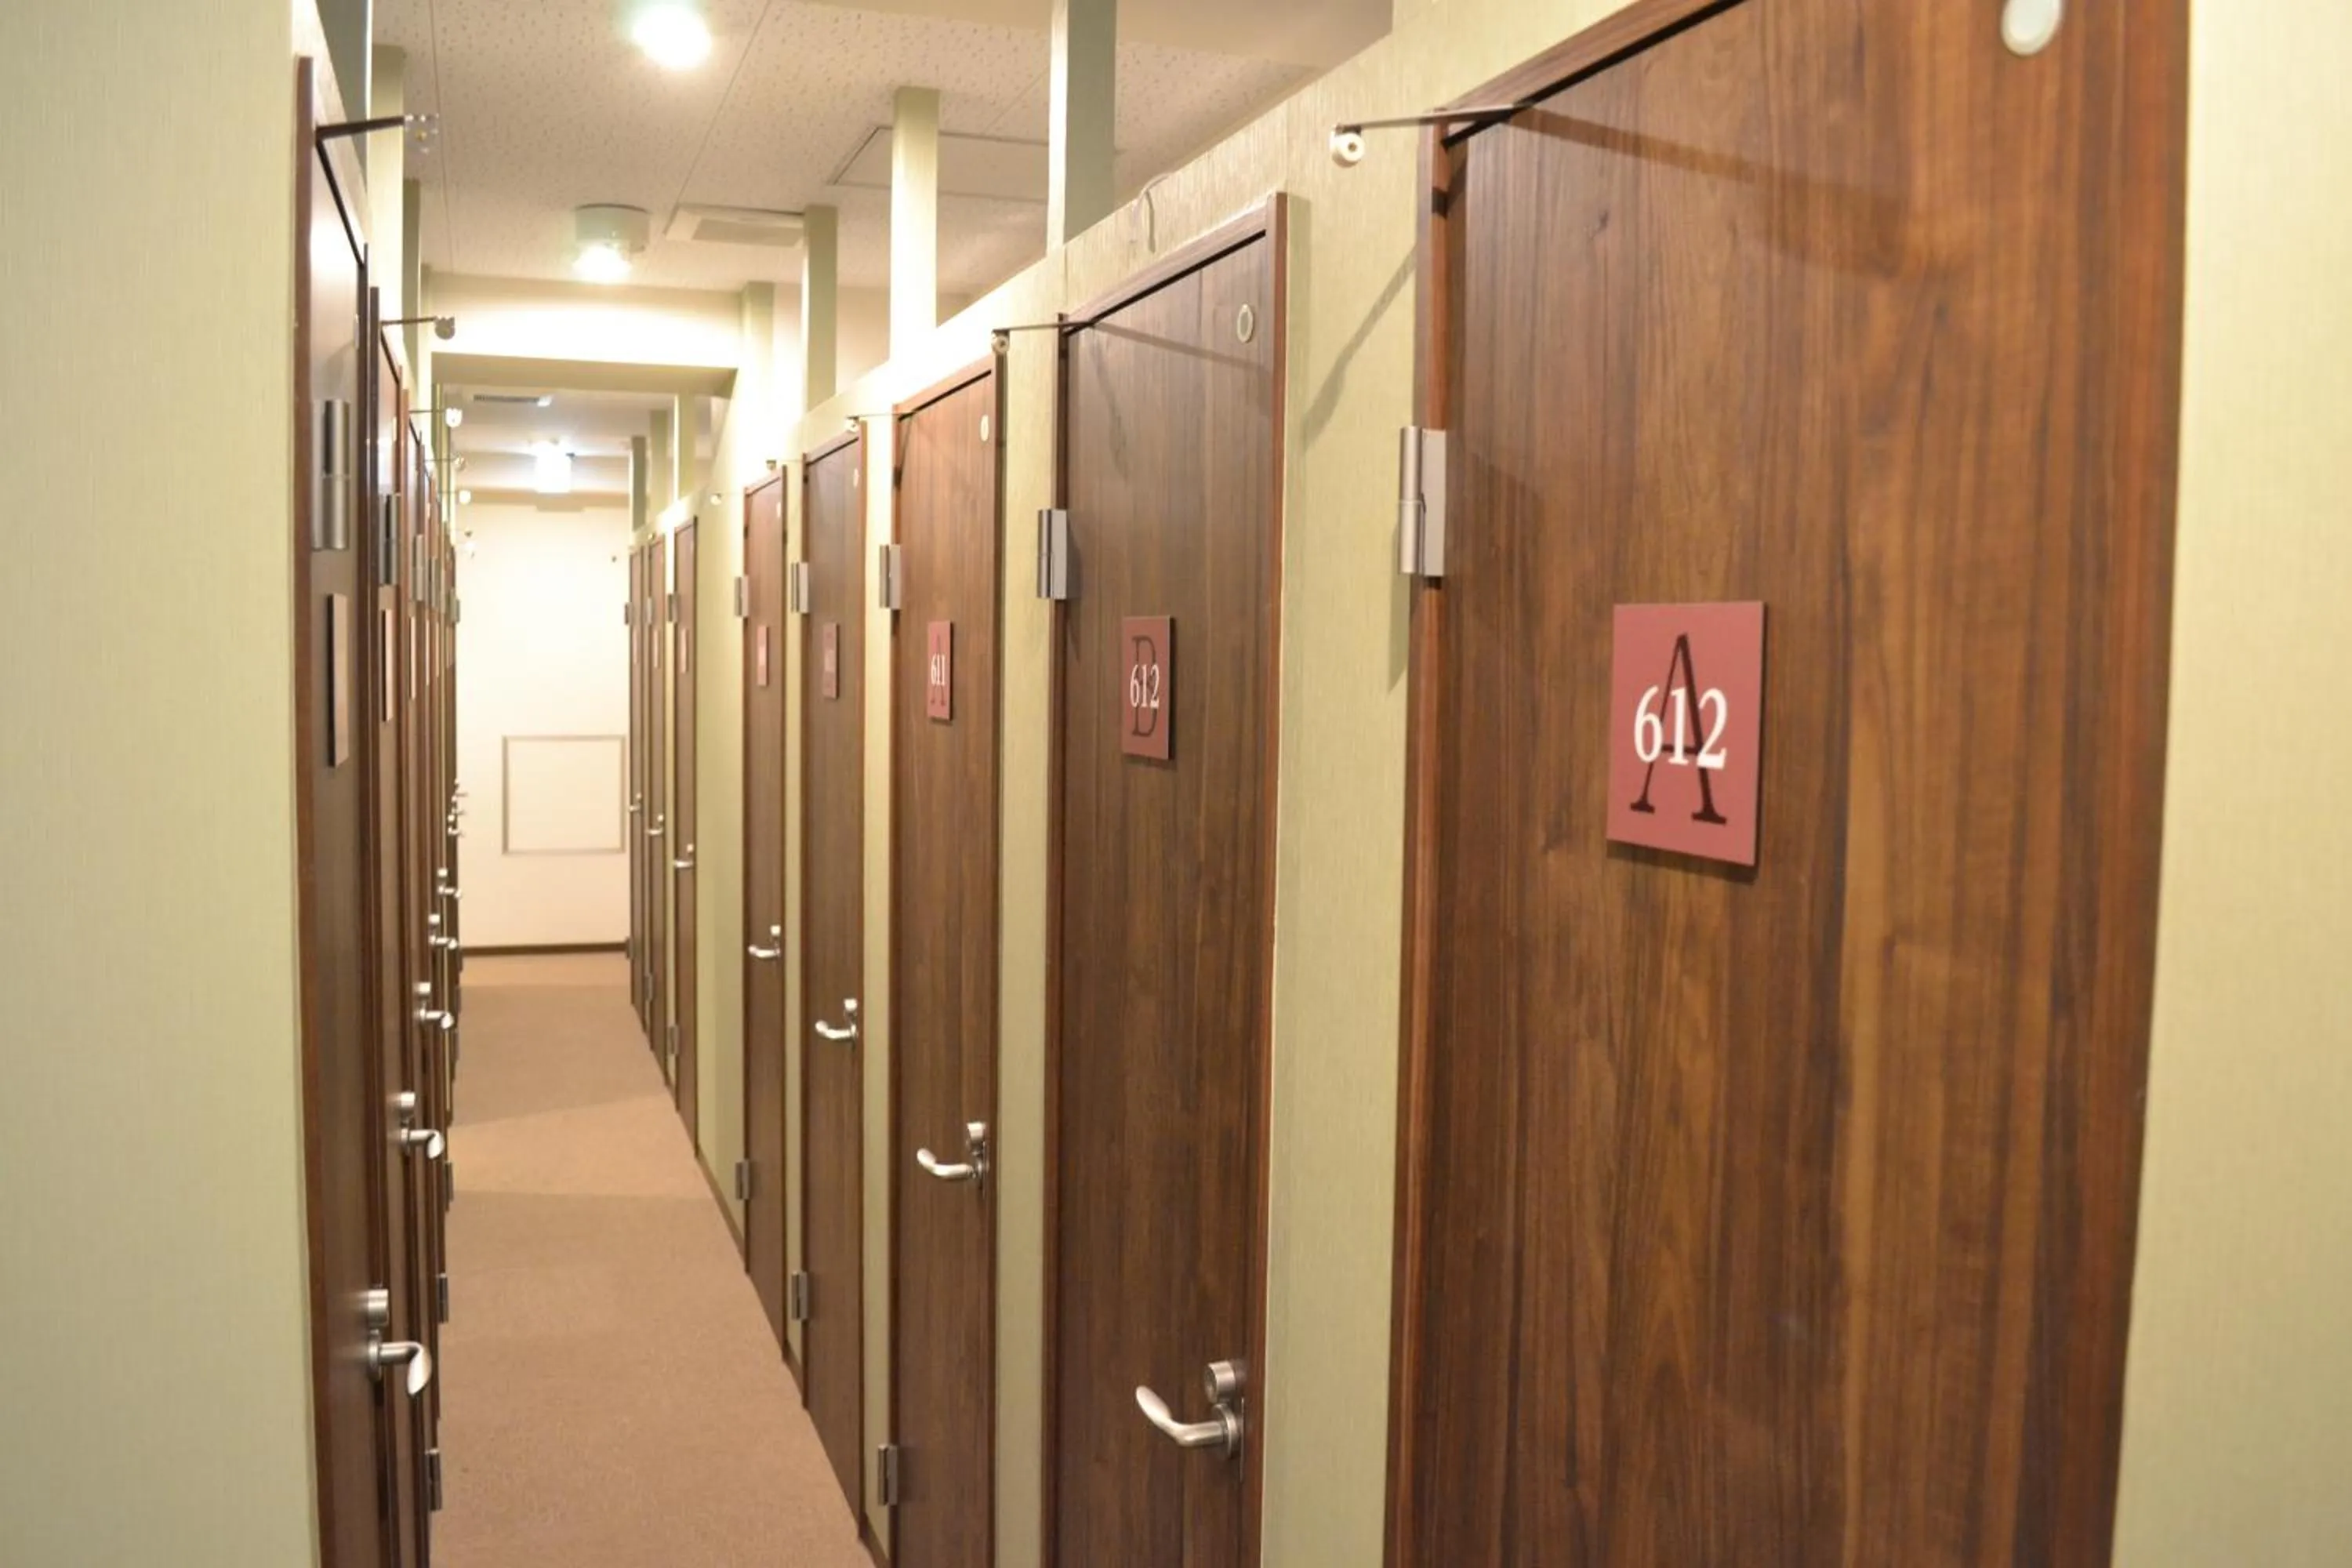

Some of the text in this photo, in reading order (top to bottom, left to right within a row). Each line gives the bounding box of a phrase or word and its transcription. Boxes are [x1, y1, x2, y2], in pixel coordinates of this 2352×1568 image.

[1130, 664, 1160, 709] 612
[1629, 632, 1728, 825] A
[1633, 684, 1728, 770] 612
